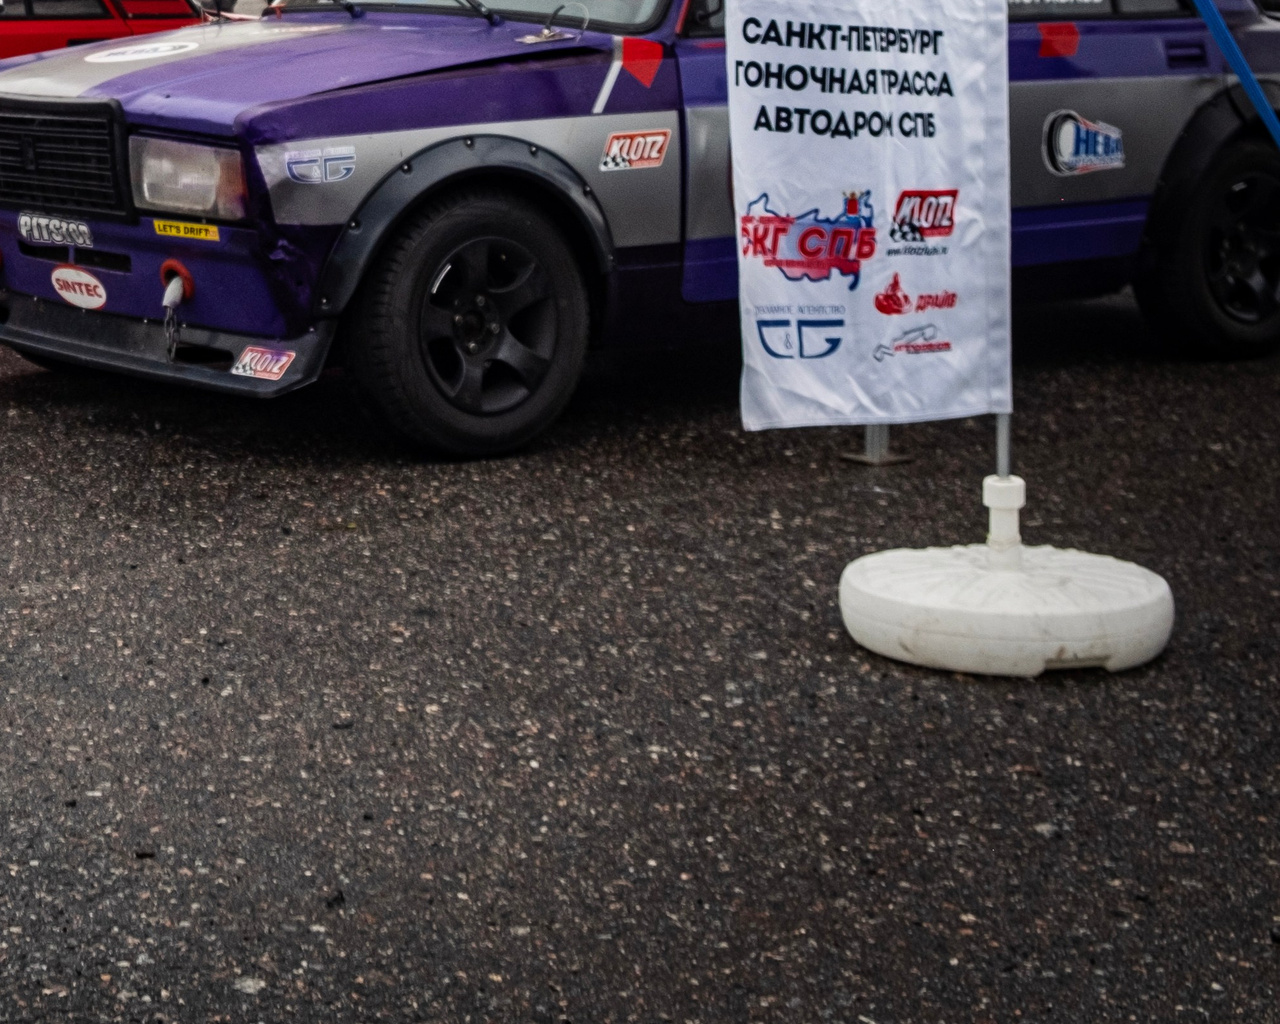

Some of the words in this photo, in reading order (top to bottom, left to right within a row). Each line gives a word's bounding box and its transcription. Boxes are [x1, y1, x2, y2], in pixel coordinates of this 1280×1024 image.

[742, 17, 943, 55] САНКТ-ПЕТЕРБУРГ
[735, 60, 877, 94] ГОНОЧНАЯ
[880, 69, 954, 97] ТРАССА
[899, 112, 936, 138] СПБ
[609, 136, 666, 160] KLOTZ
[19, 214, 93, 247] PITSTOP
[158, 224, 181, 234] LET'S
[183, 226, 210, 237] DRIFT
[797, 226, 877, 260] СПБ
[55, 278, 102, 298] SINTEC
[242, 351, 289, 373] KLOTZ
